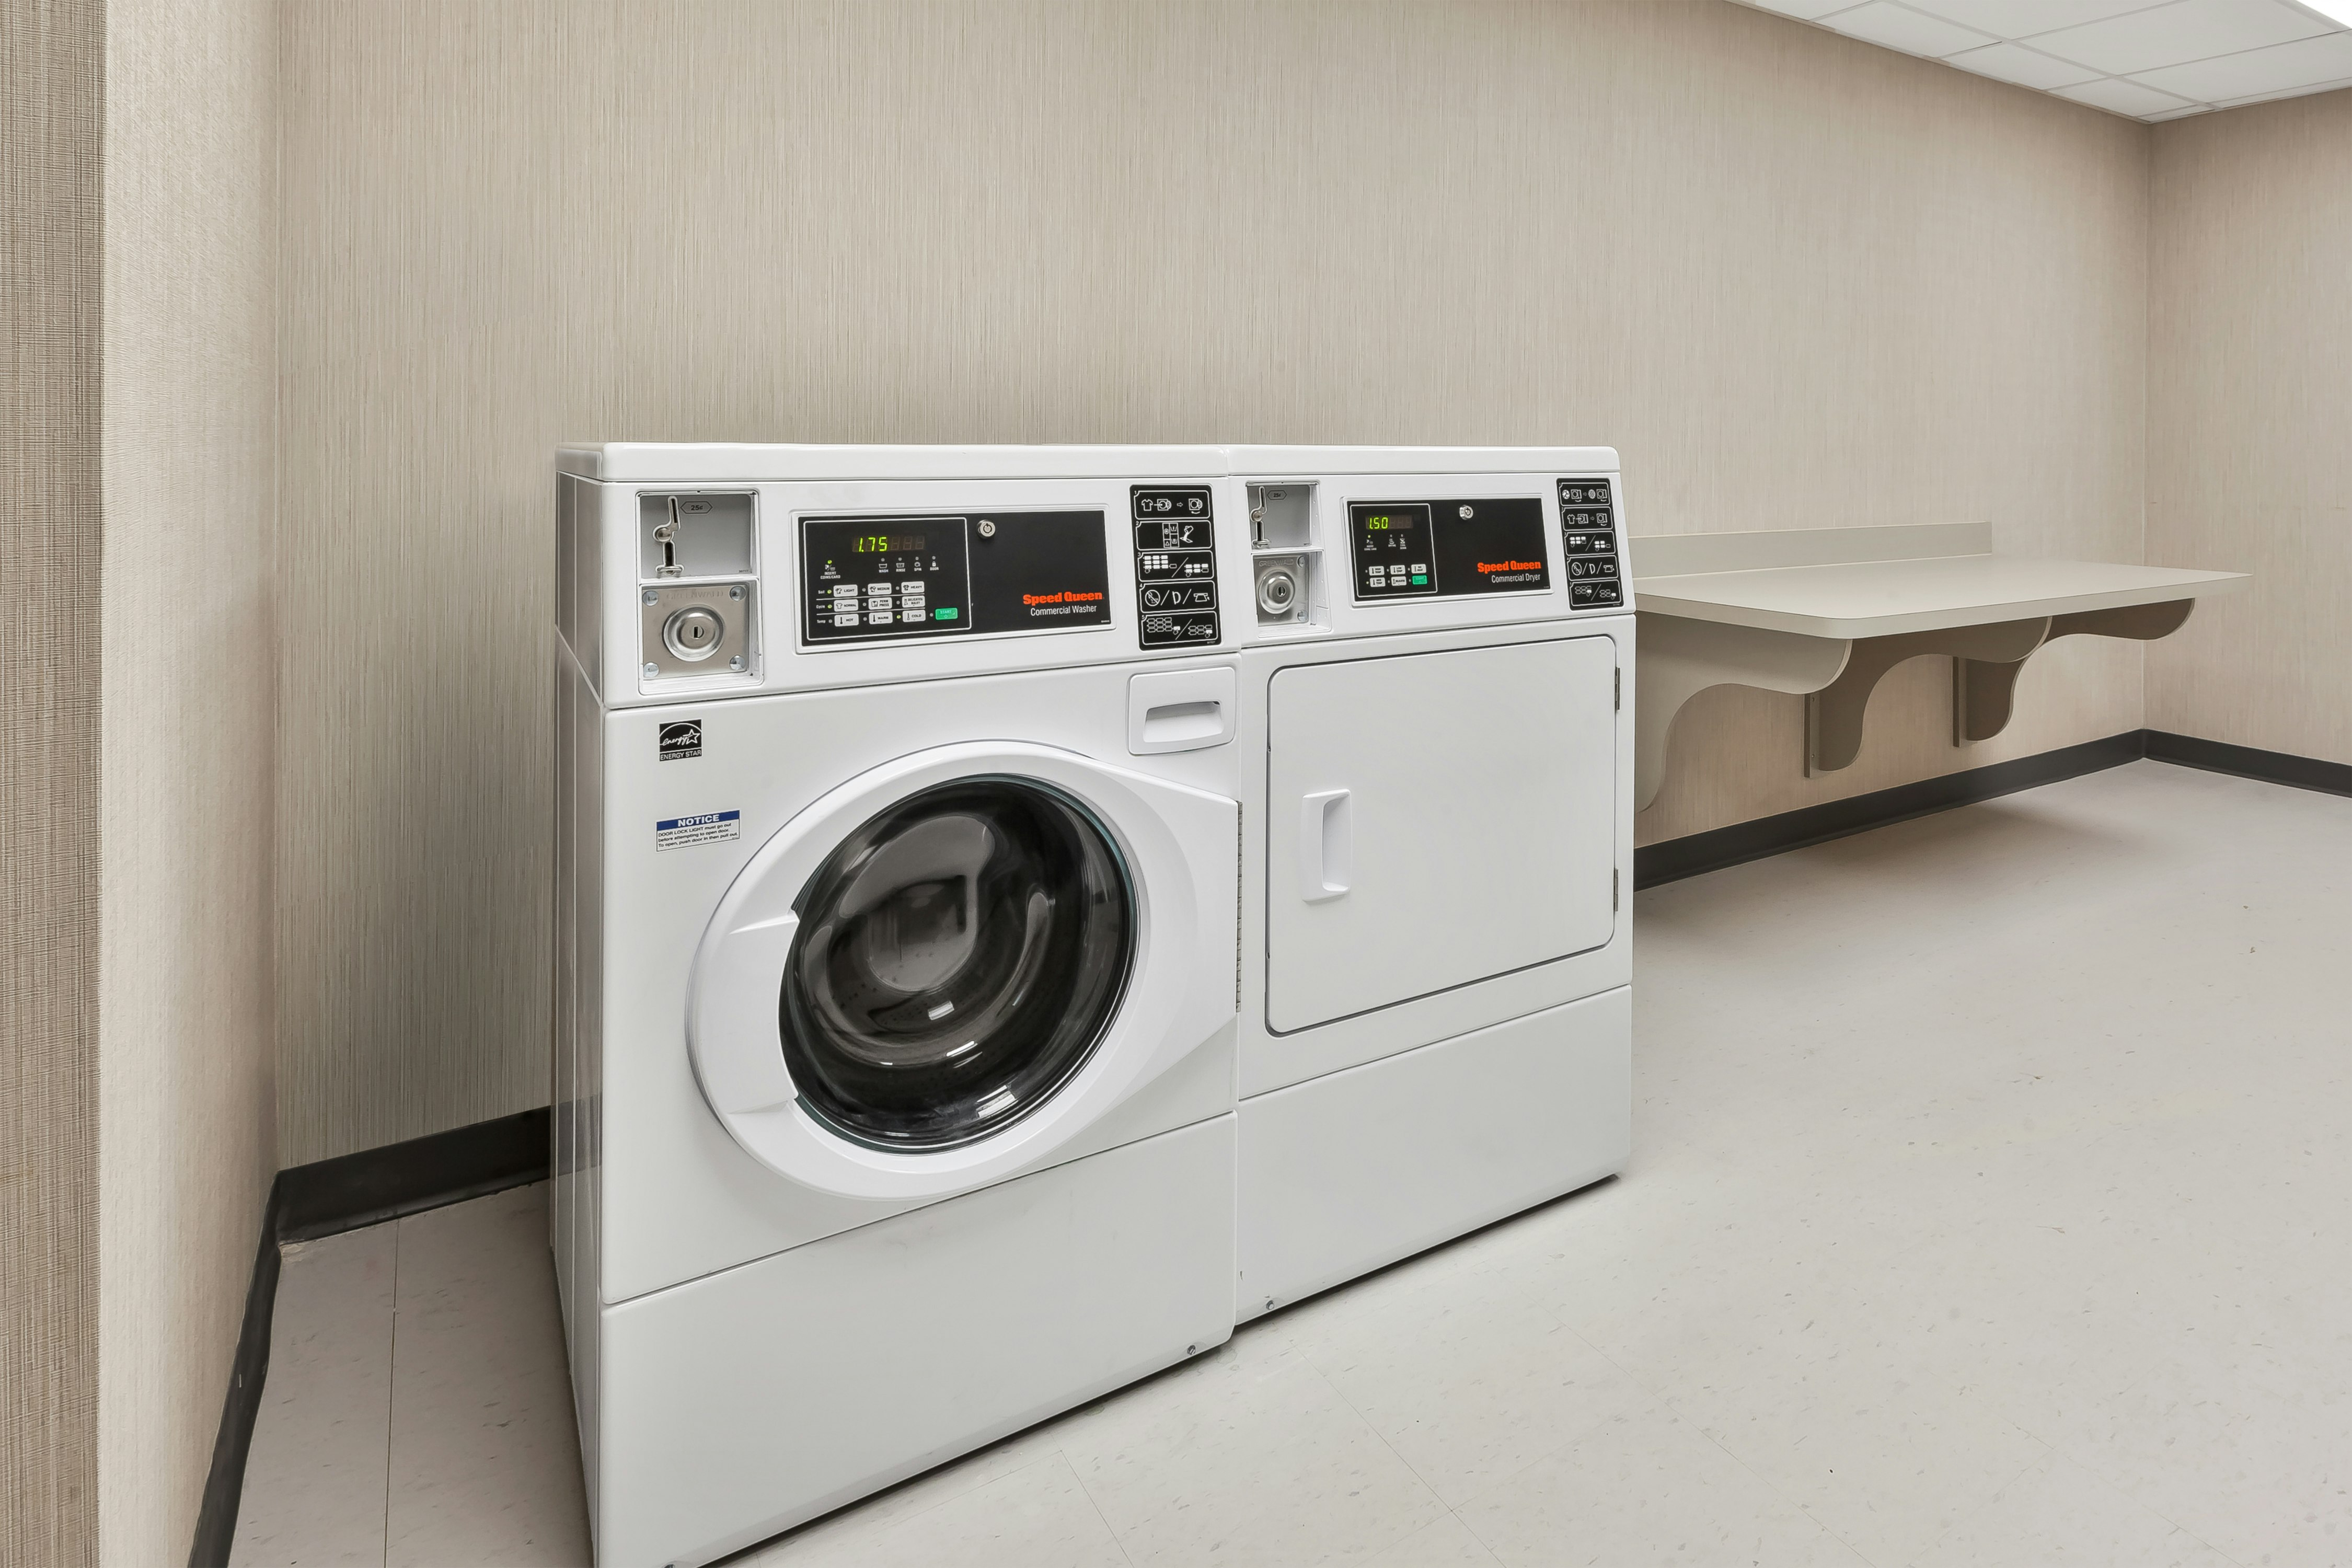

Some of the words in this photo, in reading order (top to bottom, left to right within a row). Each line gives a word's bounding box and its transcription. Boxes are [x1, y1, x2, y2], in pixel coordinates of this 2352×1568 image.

[1369, 517, 1388, 529] 1.50
[859, 536, 887, 552] 1.75
[1477, 561, 1509, 574] Speed
[1510, 560, 1541, 570] Queen
[1491, 574, 1524, 583] Commercial
[1526, 573, 1540, 582] Dryer
[1023, 592, 1062, 606] Speed
[1064, 592, 1102, 602] Queen
[1030, 606, 1070, 616] Commercial
[1072, 605, 1097, 614] Washer
[660, 752, 684, 760] ENERGY
[678, 814, 719, 827] NOTICE
